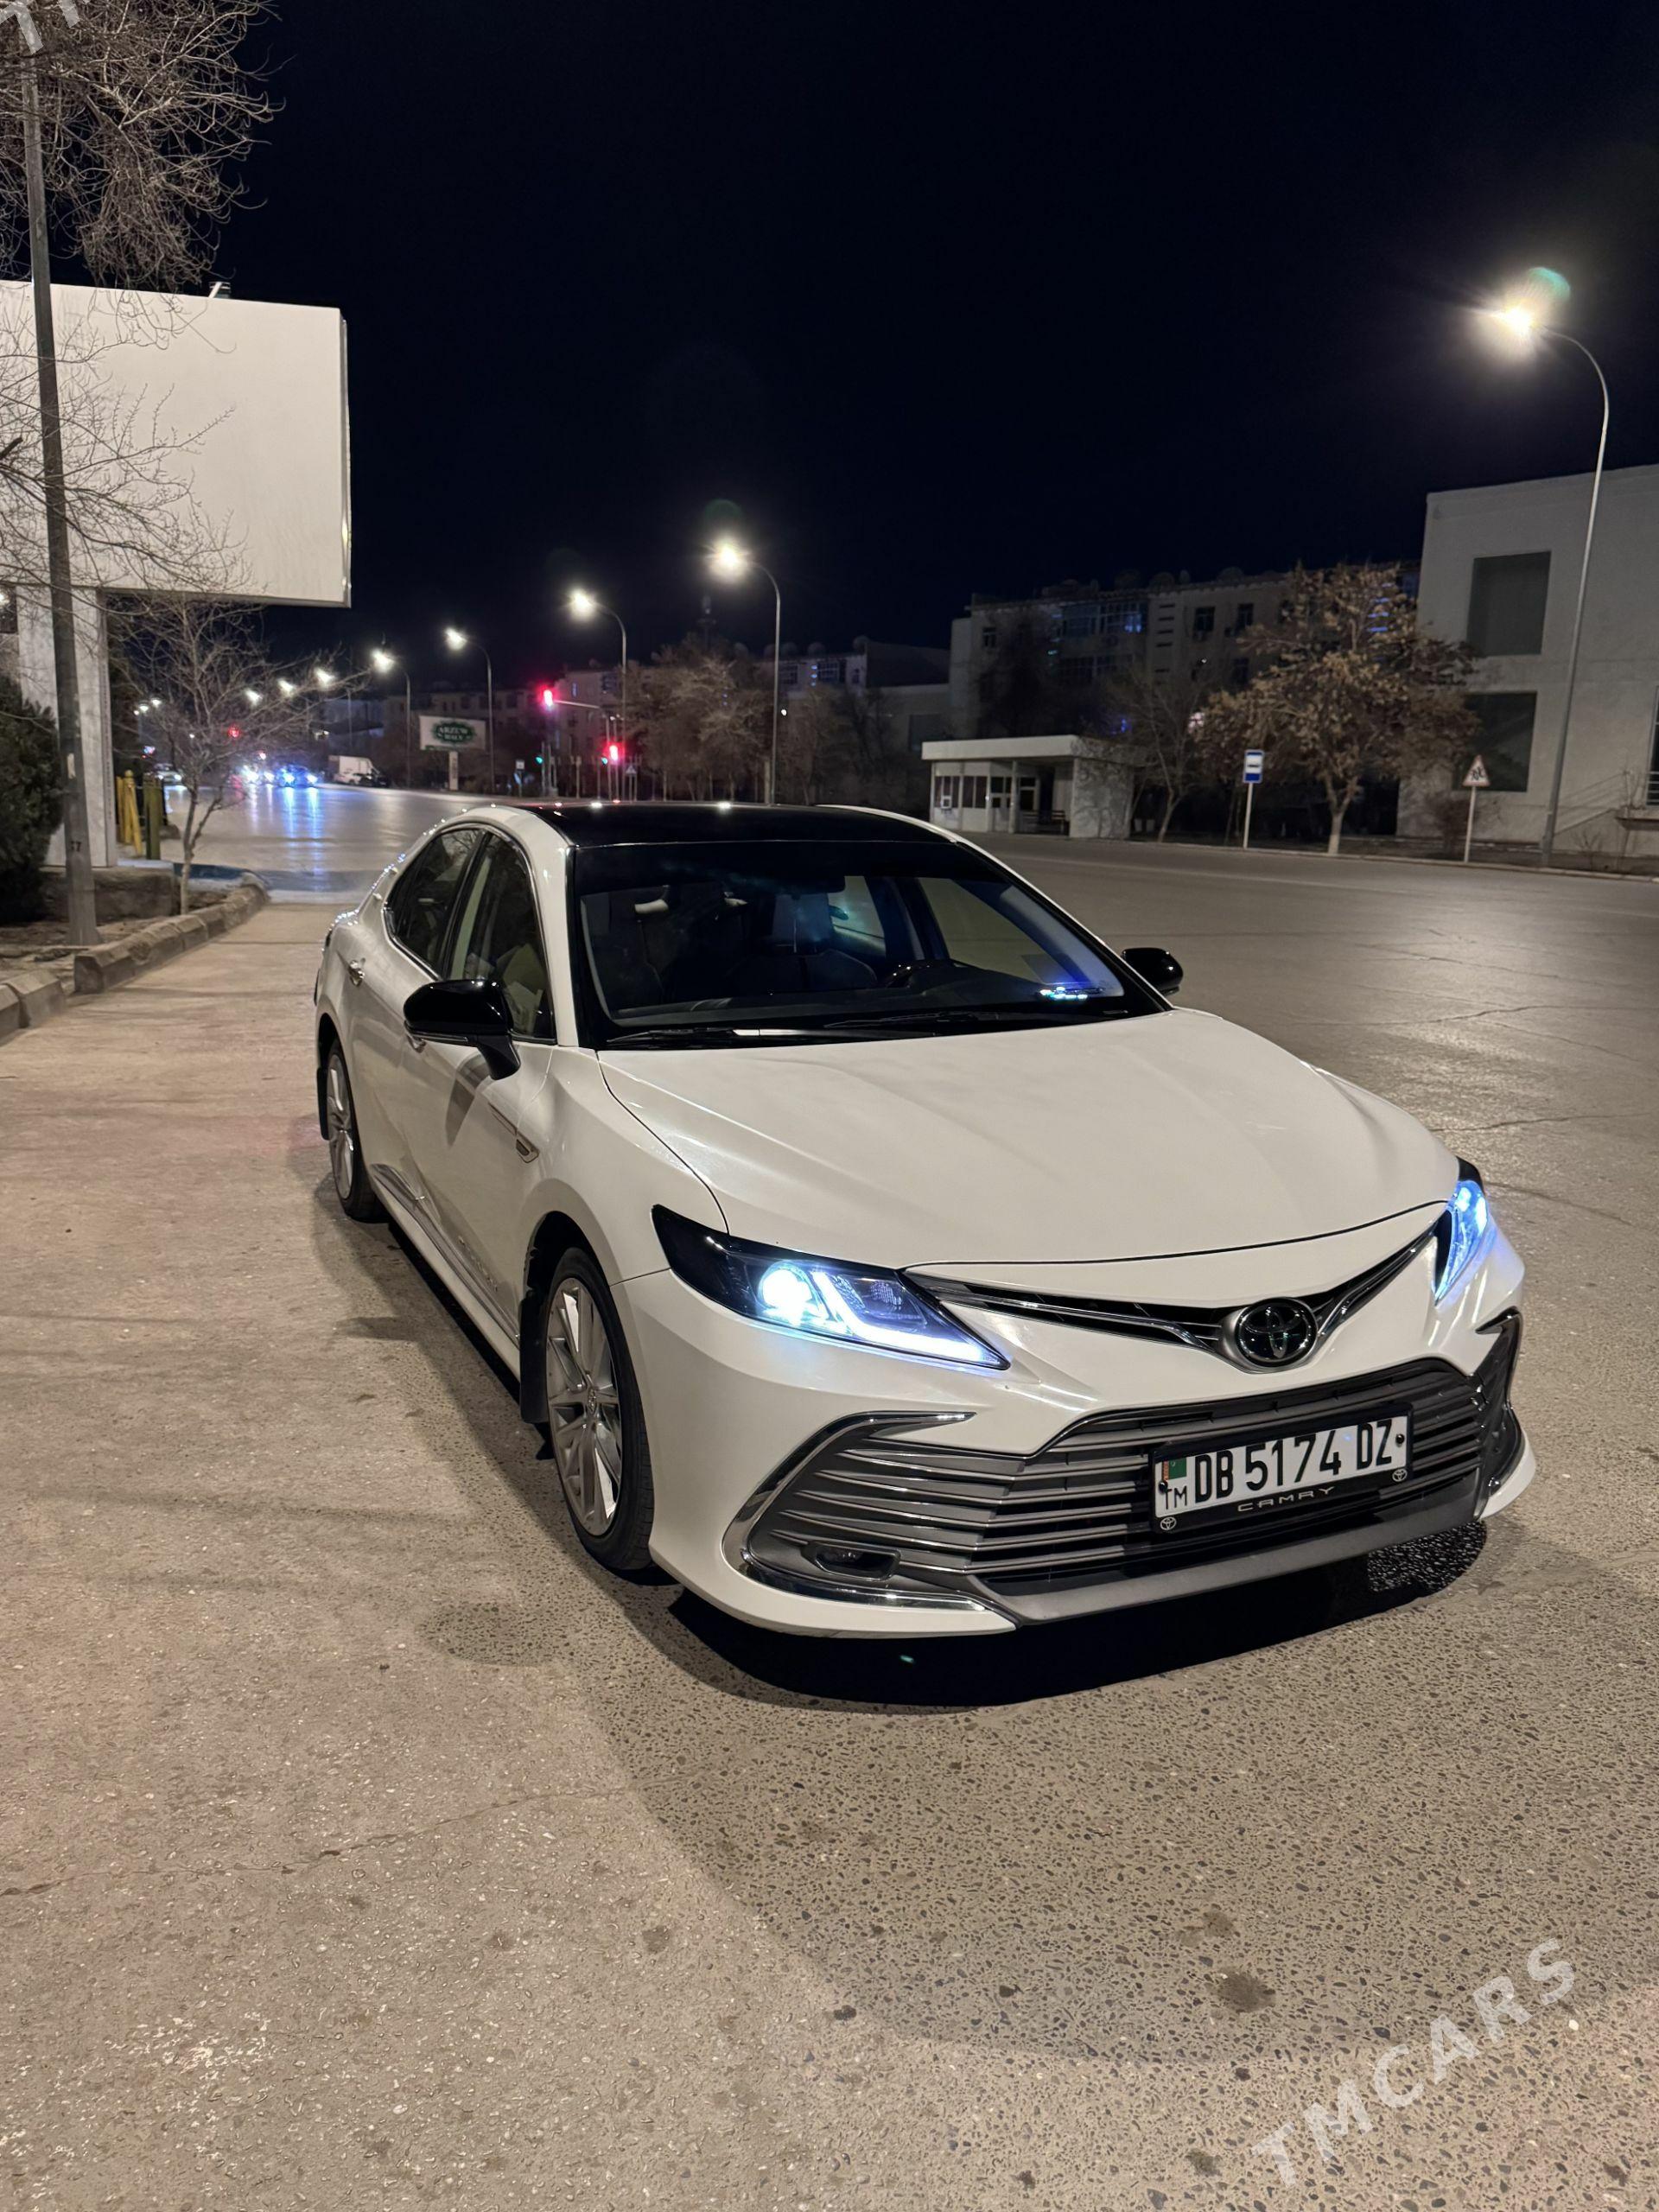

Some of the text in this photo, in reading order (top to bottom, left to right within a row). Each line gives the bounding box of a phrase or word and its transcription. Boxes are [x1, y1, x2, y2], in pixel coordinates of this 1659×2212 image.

[1194, 1419, 1393, 1503] DB 5174 DZ
[1162, 1485, 1187, 1510] TM
[1237, 1485, 1335, 1512] CAMRY
